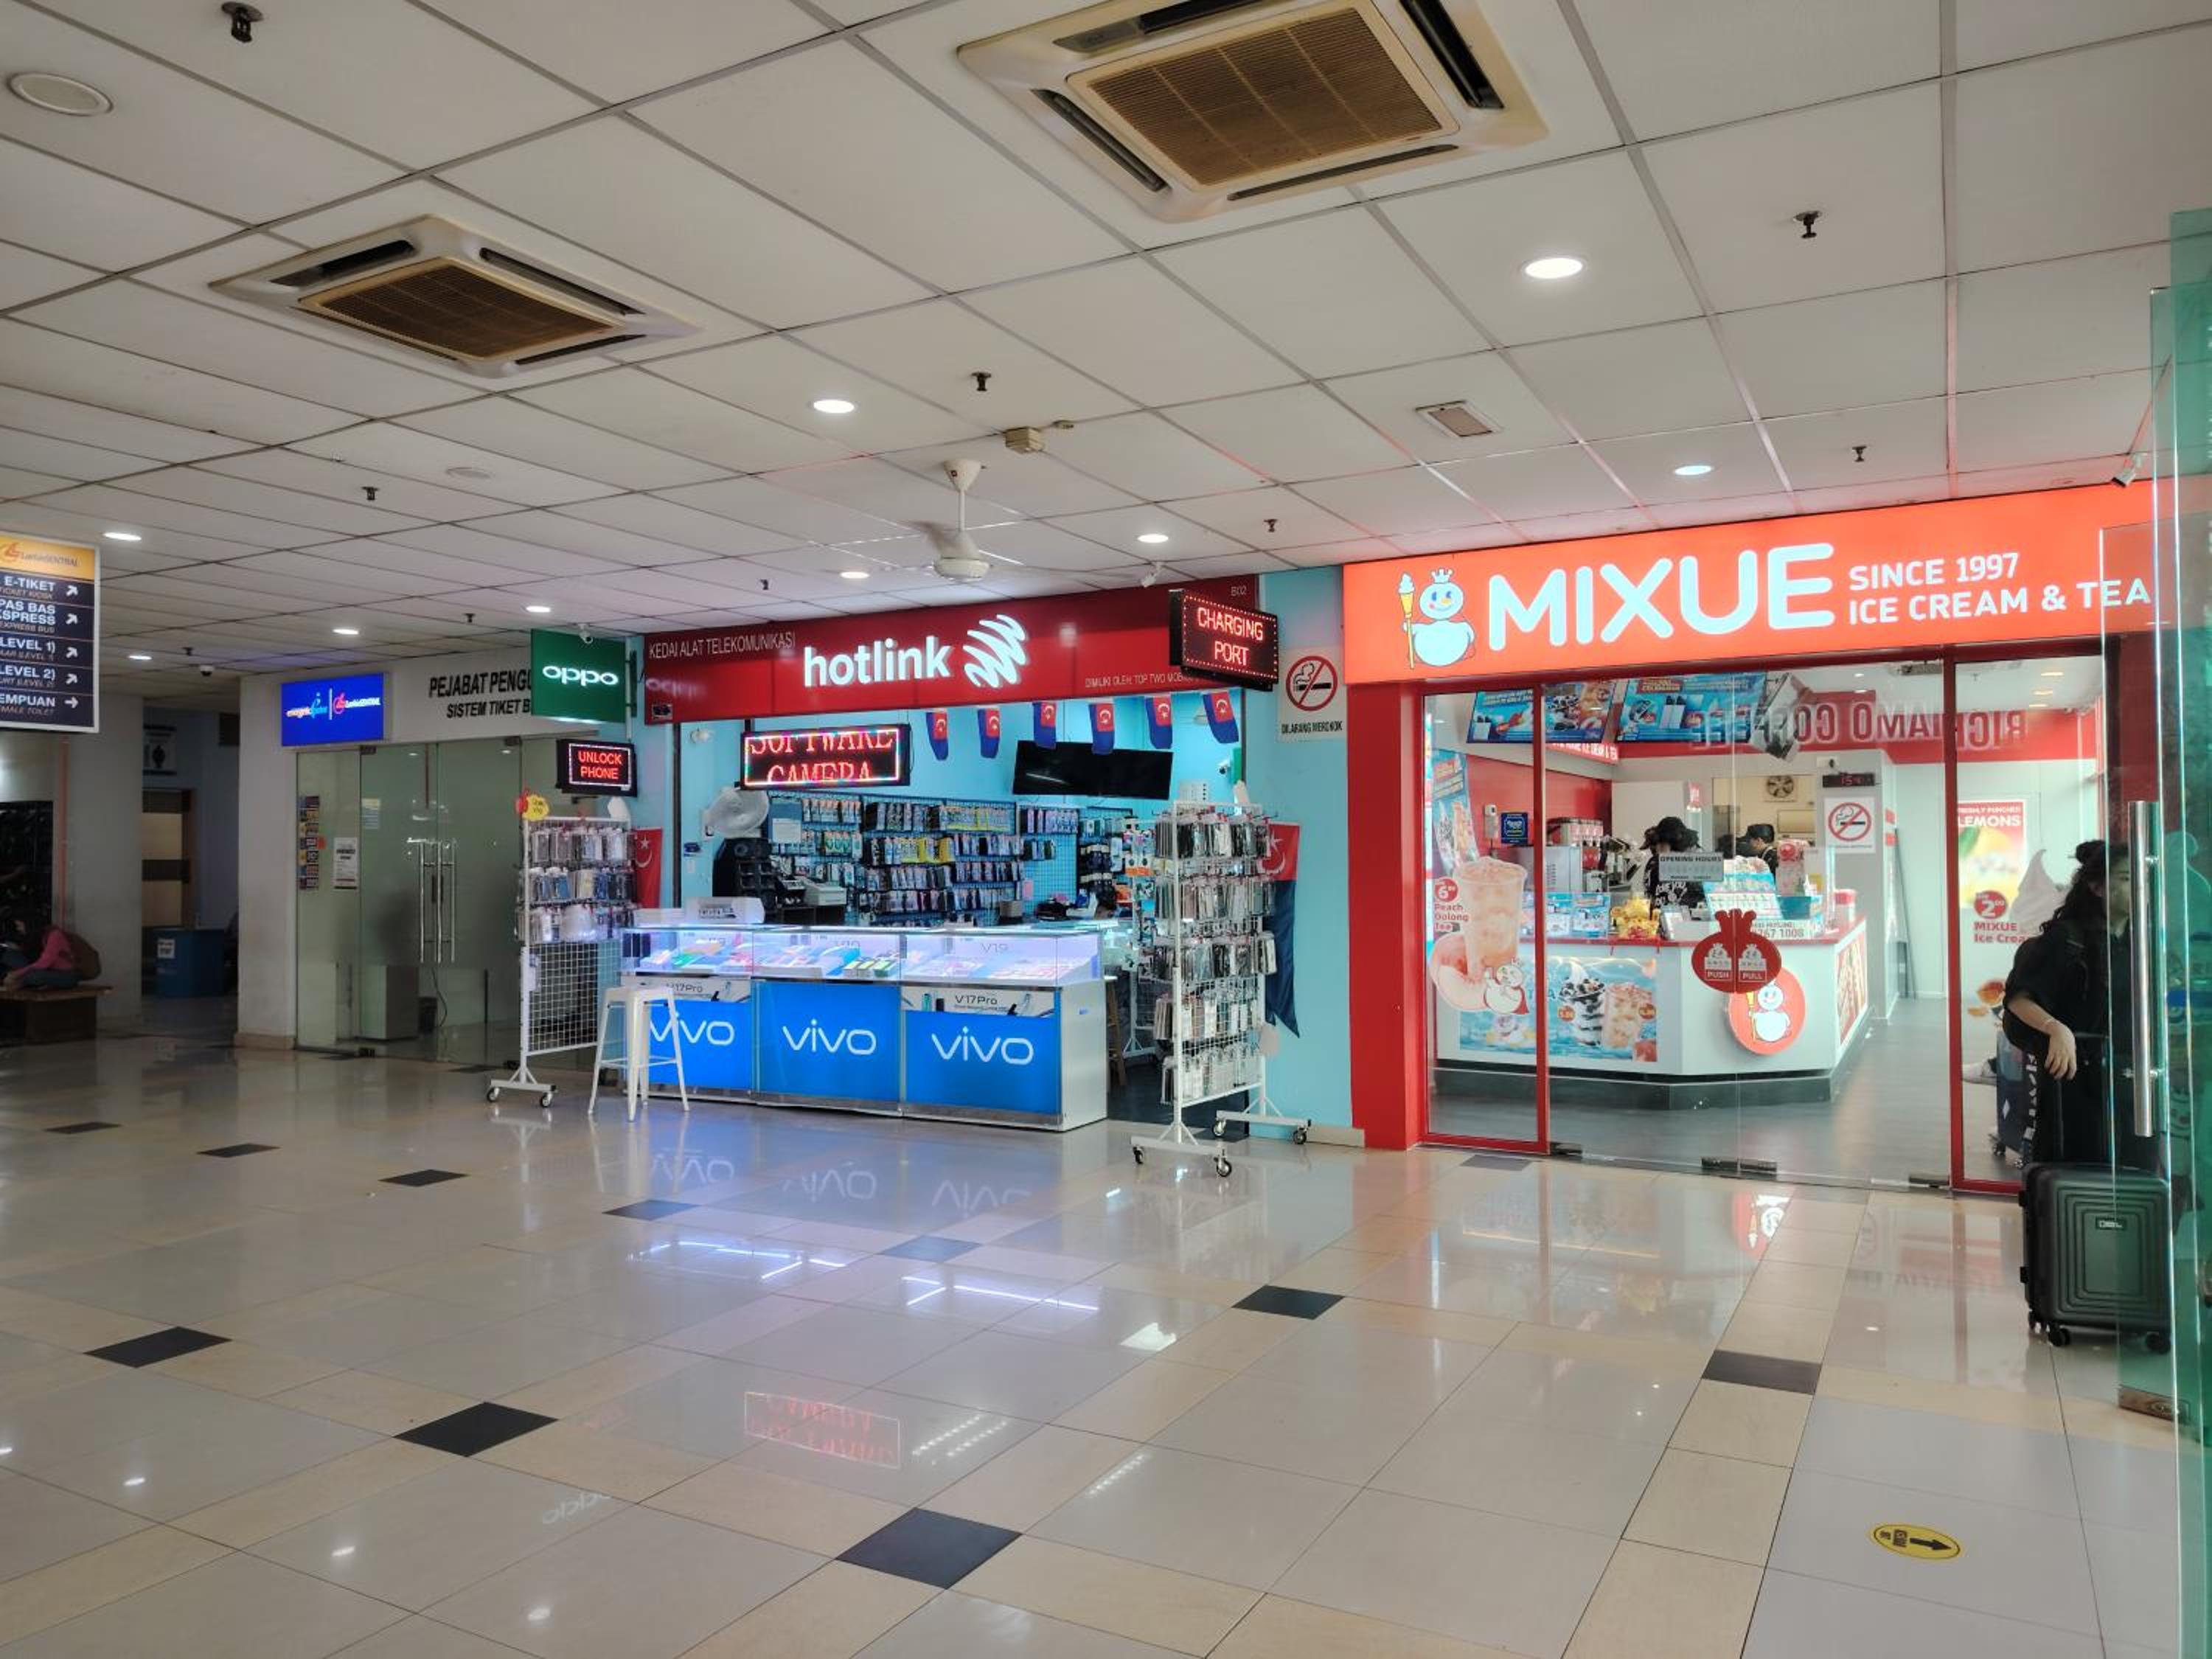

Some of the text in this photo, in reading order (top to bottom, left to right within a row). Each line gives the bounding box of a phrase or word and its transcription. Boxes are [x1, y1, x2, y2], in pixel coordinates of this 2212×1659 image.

[1848, 552, 2019, 591] SINCE 1997
[4, 576, 56, 591] E-TIKET
[1489, 542, 1835, 652] MIXUE
[1848, 577, 2151, 625] ICE CREAM & TEA
[28, 602, 56, 615] BAS
[0, 610, 56, 625] SPRESS
[1197, 607, 1264, 641] CHARGING
[0, 637, 42, 651] LEVEL
[649, 631, 796, 659] KEDAI ALAT TELEKOMUNIKASI
[804, 635, 950, 687] hotlink
[1214, 641, 1250, 666] PORT
[43, 669, 56, 681] 2)
[543, 665, 619, 686] oppo
[1150, 673, 1166, 684] TWO
[428, 672, 487, 698] PEJABAT
[446, 700, 487, 719] SISTEM
[489, 698, 522, 716] TIKET
[577, 750, 622, 765] UNLOCK
[580, 767, 619, 779] PHONE
[1958, 815, 2021, 827] LEMONS
[1974, 922, 2018, 931] MIXUE
[1974, 933, 1994, 943] Ice
[1707, 971, 1764, 981] PUSH PULL
[649, 1012, 1034, 1065] vvo vivo vivo
